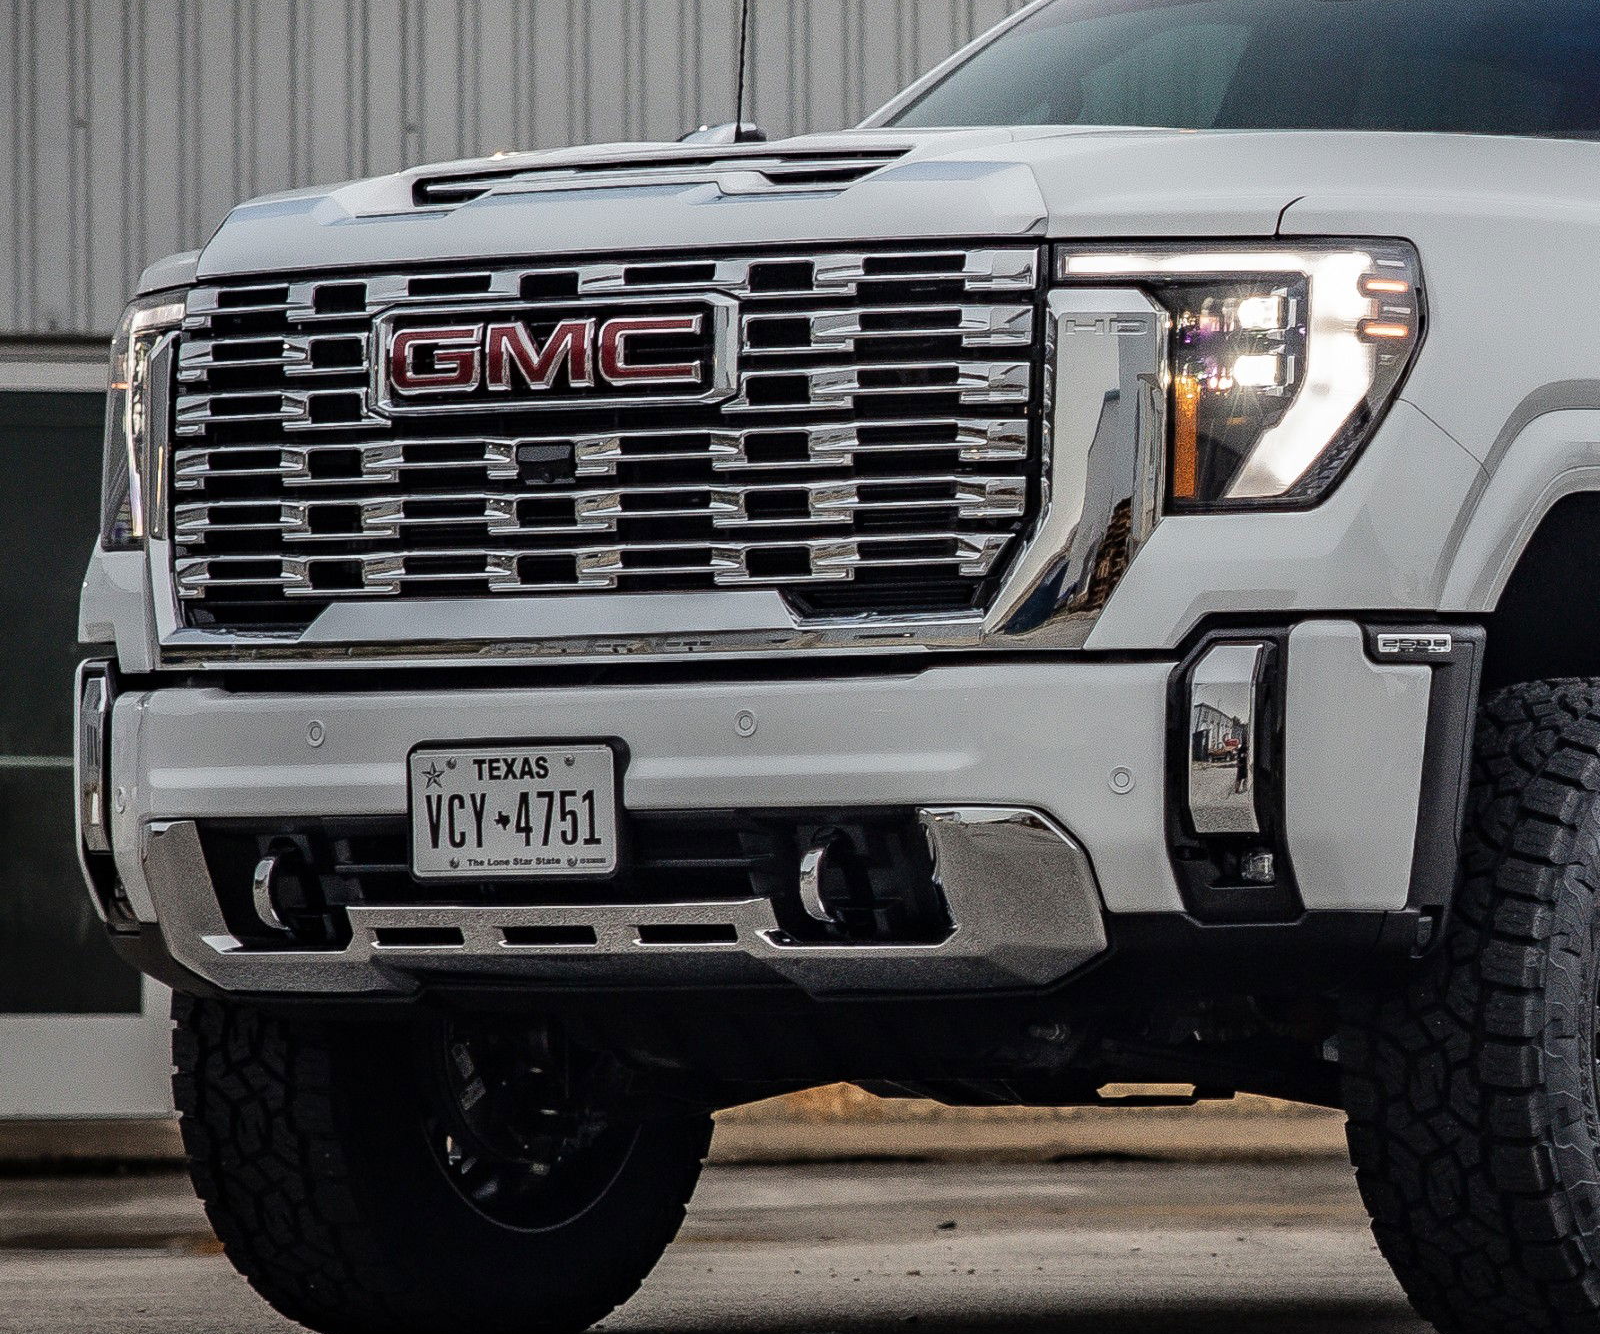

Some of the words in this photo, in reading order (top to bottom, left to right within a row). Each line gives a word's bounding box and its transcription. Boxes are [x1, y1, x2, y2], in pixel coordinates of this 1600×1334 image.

[1066, 319, 1148, 336] HD
[390, 314, 703, 397] GMC
[473, 756, 550, 781] TEXAS
[425, 792, 487, 850] VCY
[514, 789, 603, 848] 4751
[467, 858, 485, 867] The
[487, 857, 510, 867] Lone
[512, 857, 533, 866] Star
[535, 856, 562, 866] State
